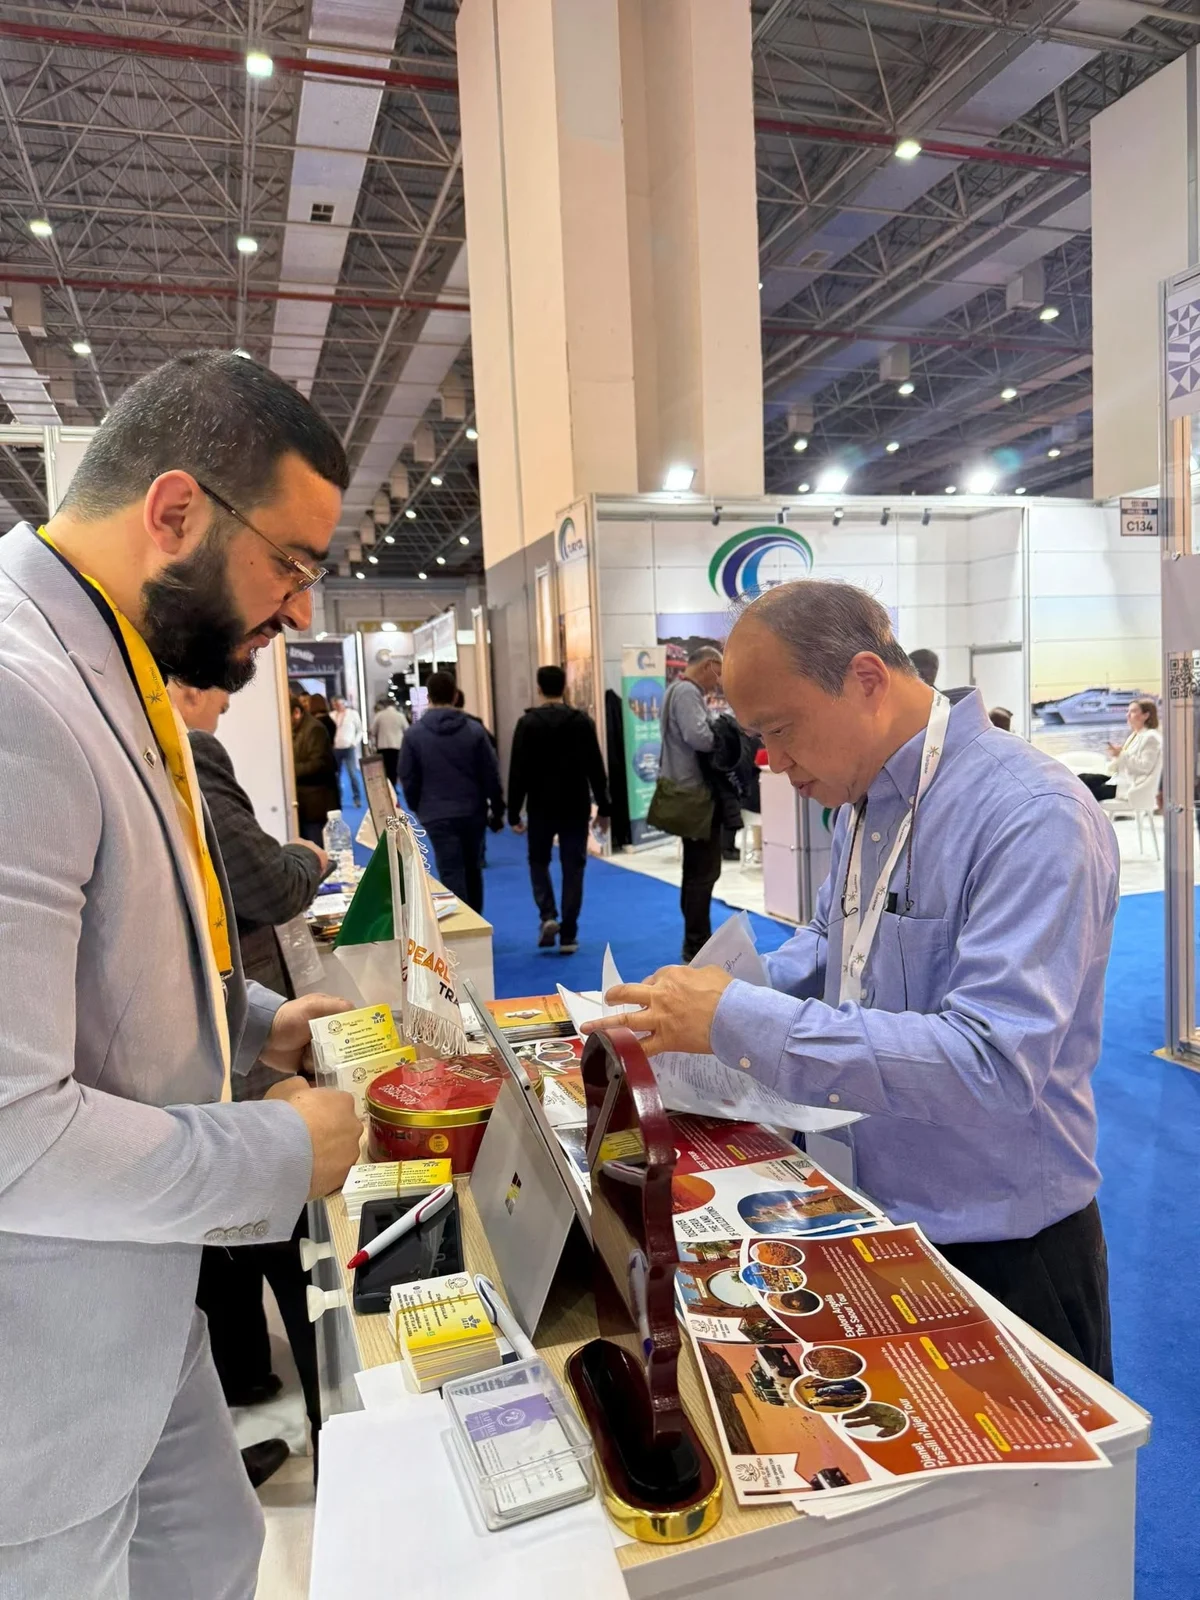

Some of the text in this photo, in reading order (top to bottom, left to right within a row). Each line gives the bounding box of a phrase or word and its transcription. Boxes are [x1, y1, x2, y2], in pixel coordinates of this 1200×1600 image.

[1126, 520, 1153, 532] C134
[407, 938, 451, 983] PEARL
[834, 1291, 849, 1306] Tour
[460, 1317, 470, 1329] IATA
[822, 1293, 856, 1337] Explora Argelia
[853, 1323, 868, 1336] The
[896, 1397, 951, 1465] Tassili n'Ajjer Tour
[909, 1441, 938, 1467] Djanet
